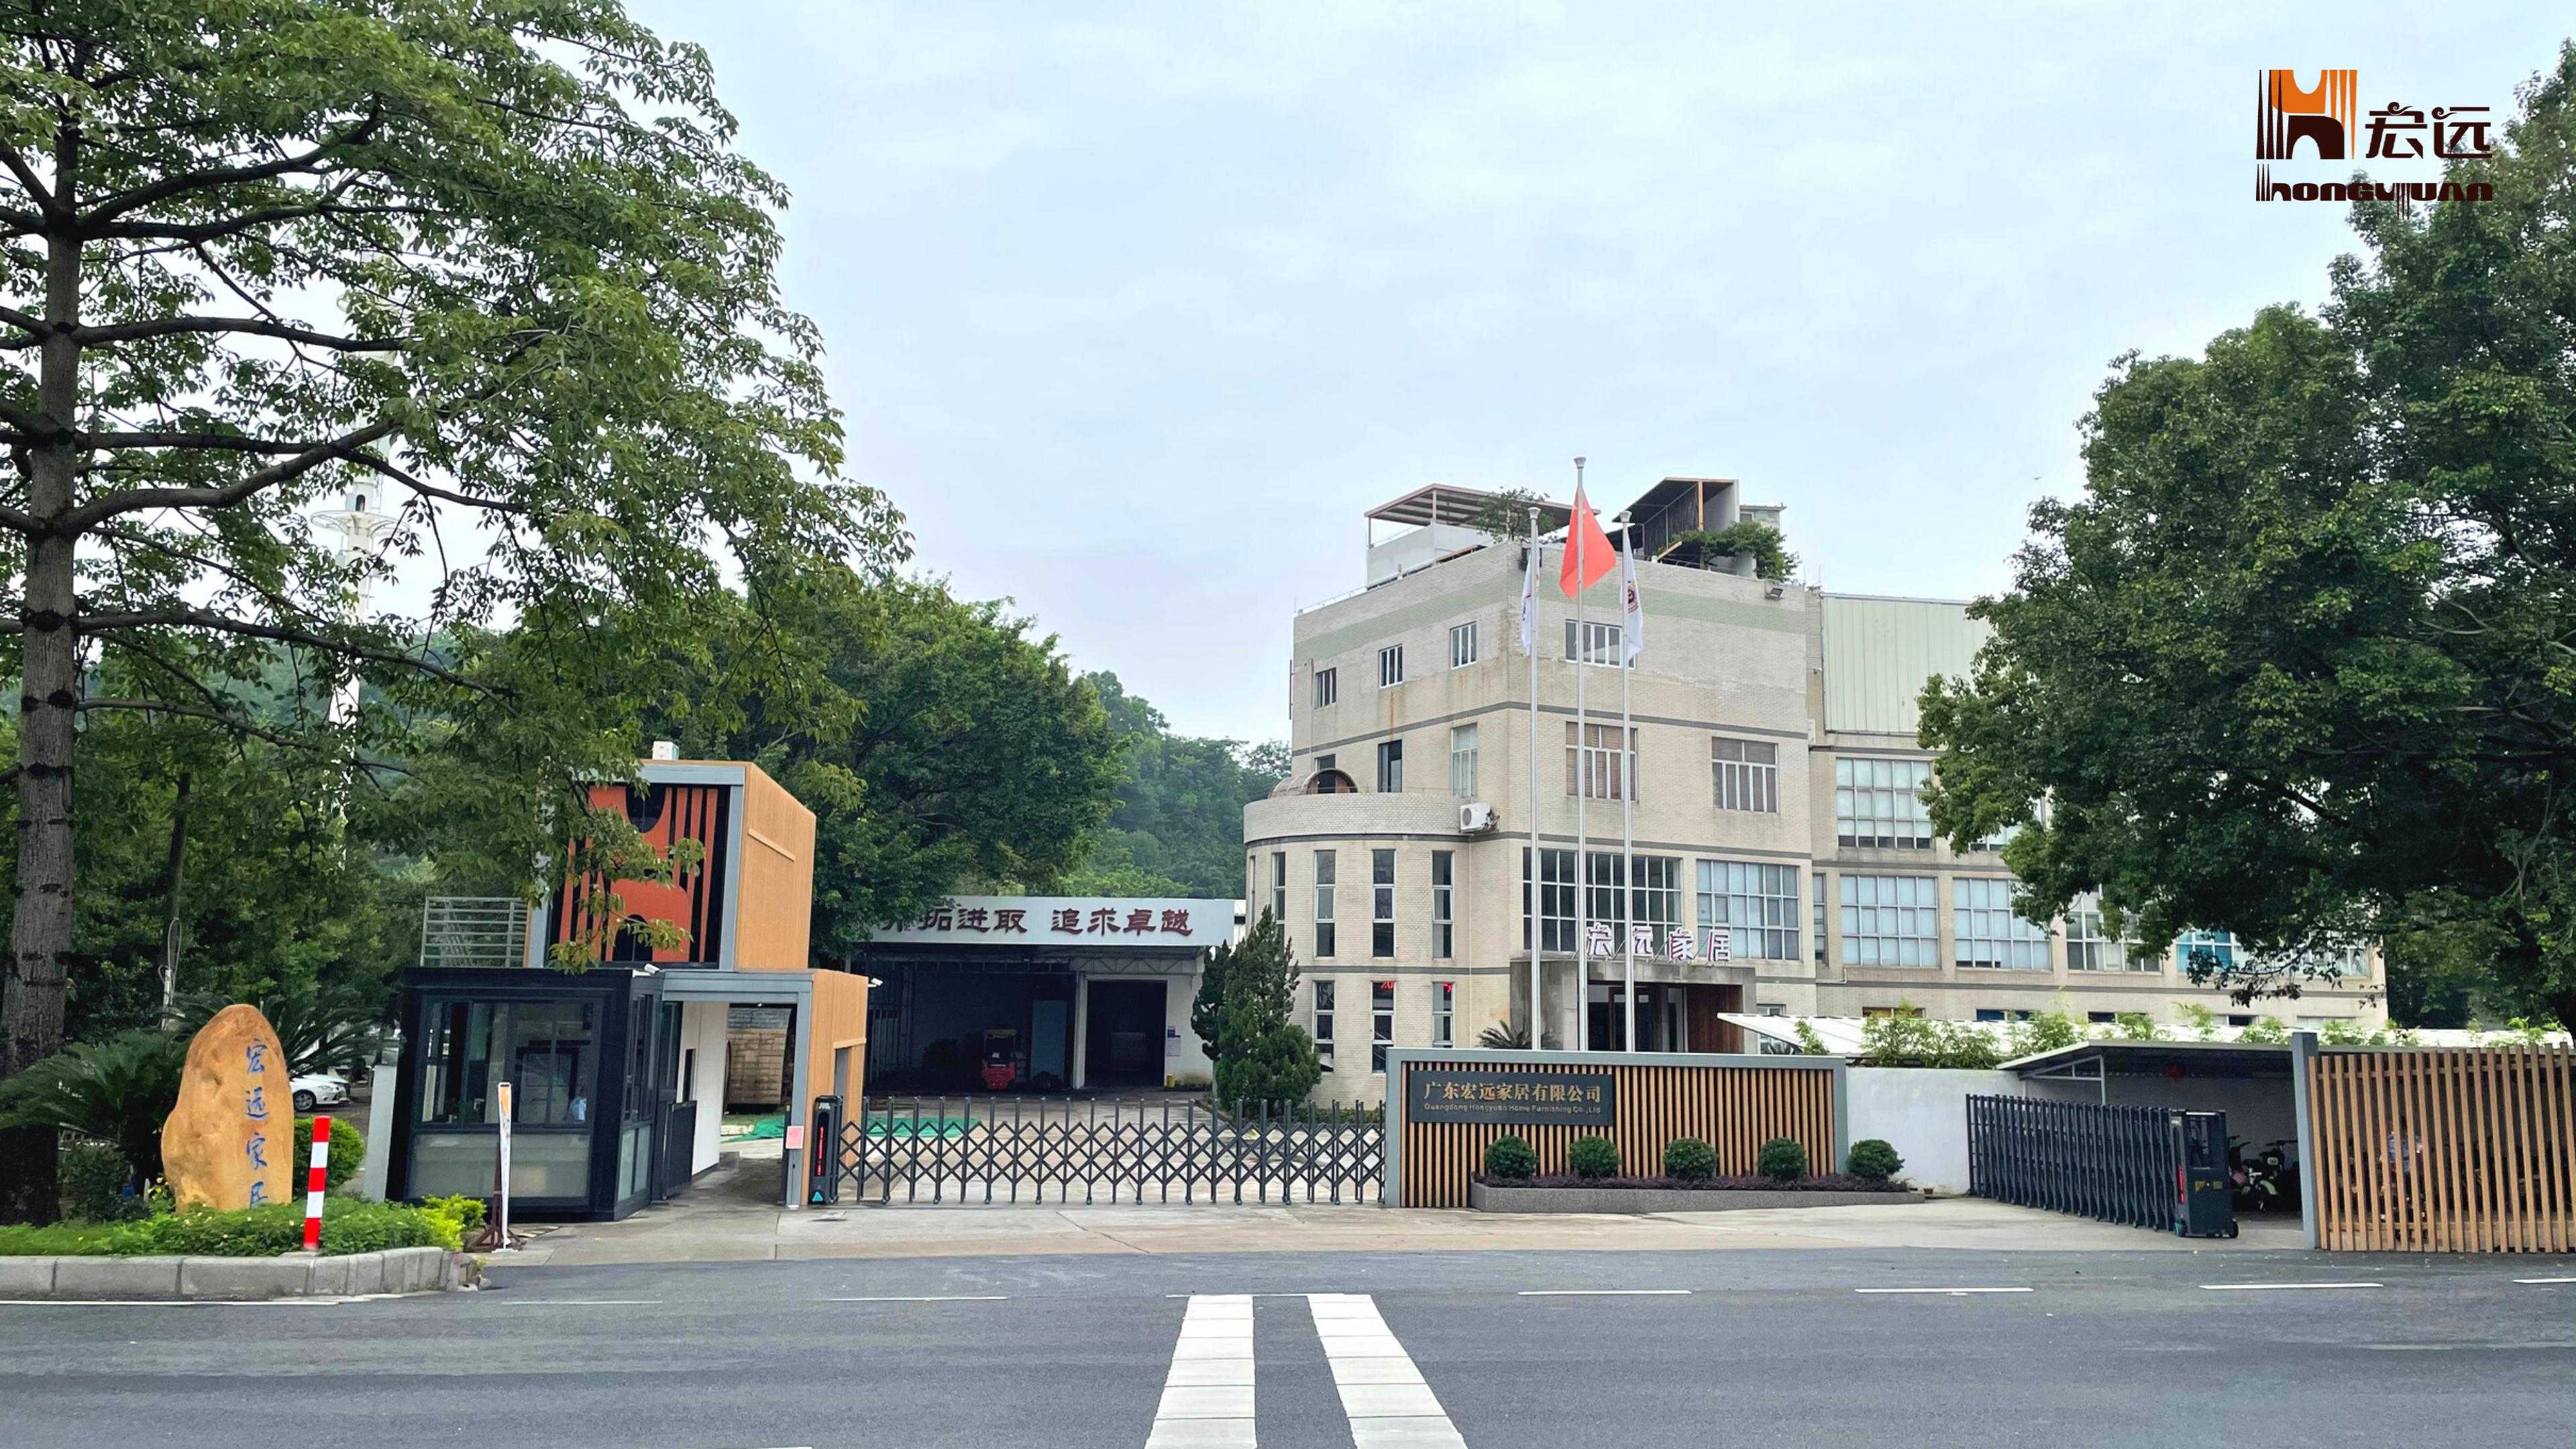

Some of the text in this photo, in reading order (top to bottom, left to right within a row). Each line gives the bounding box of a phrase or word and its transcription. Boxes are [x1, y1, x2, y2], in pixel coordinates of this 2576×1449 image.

[1051, 908, 1193, 936] 追求卓越
[1586, 922, 1731, 962] 宏远家居
[1424, 1081, 1601, 1103] 广东宏远家居有限公司
[1424, 1103, 1468, 1112] Guangdong
[1469, 1104, 1507, 1112] Hongyuan
[1509, 1104, 1530, 1113] Home
[1532, 1104, 1572, 1114] Furnishing
